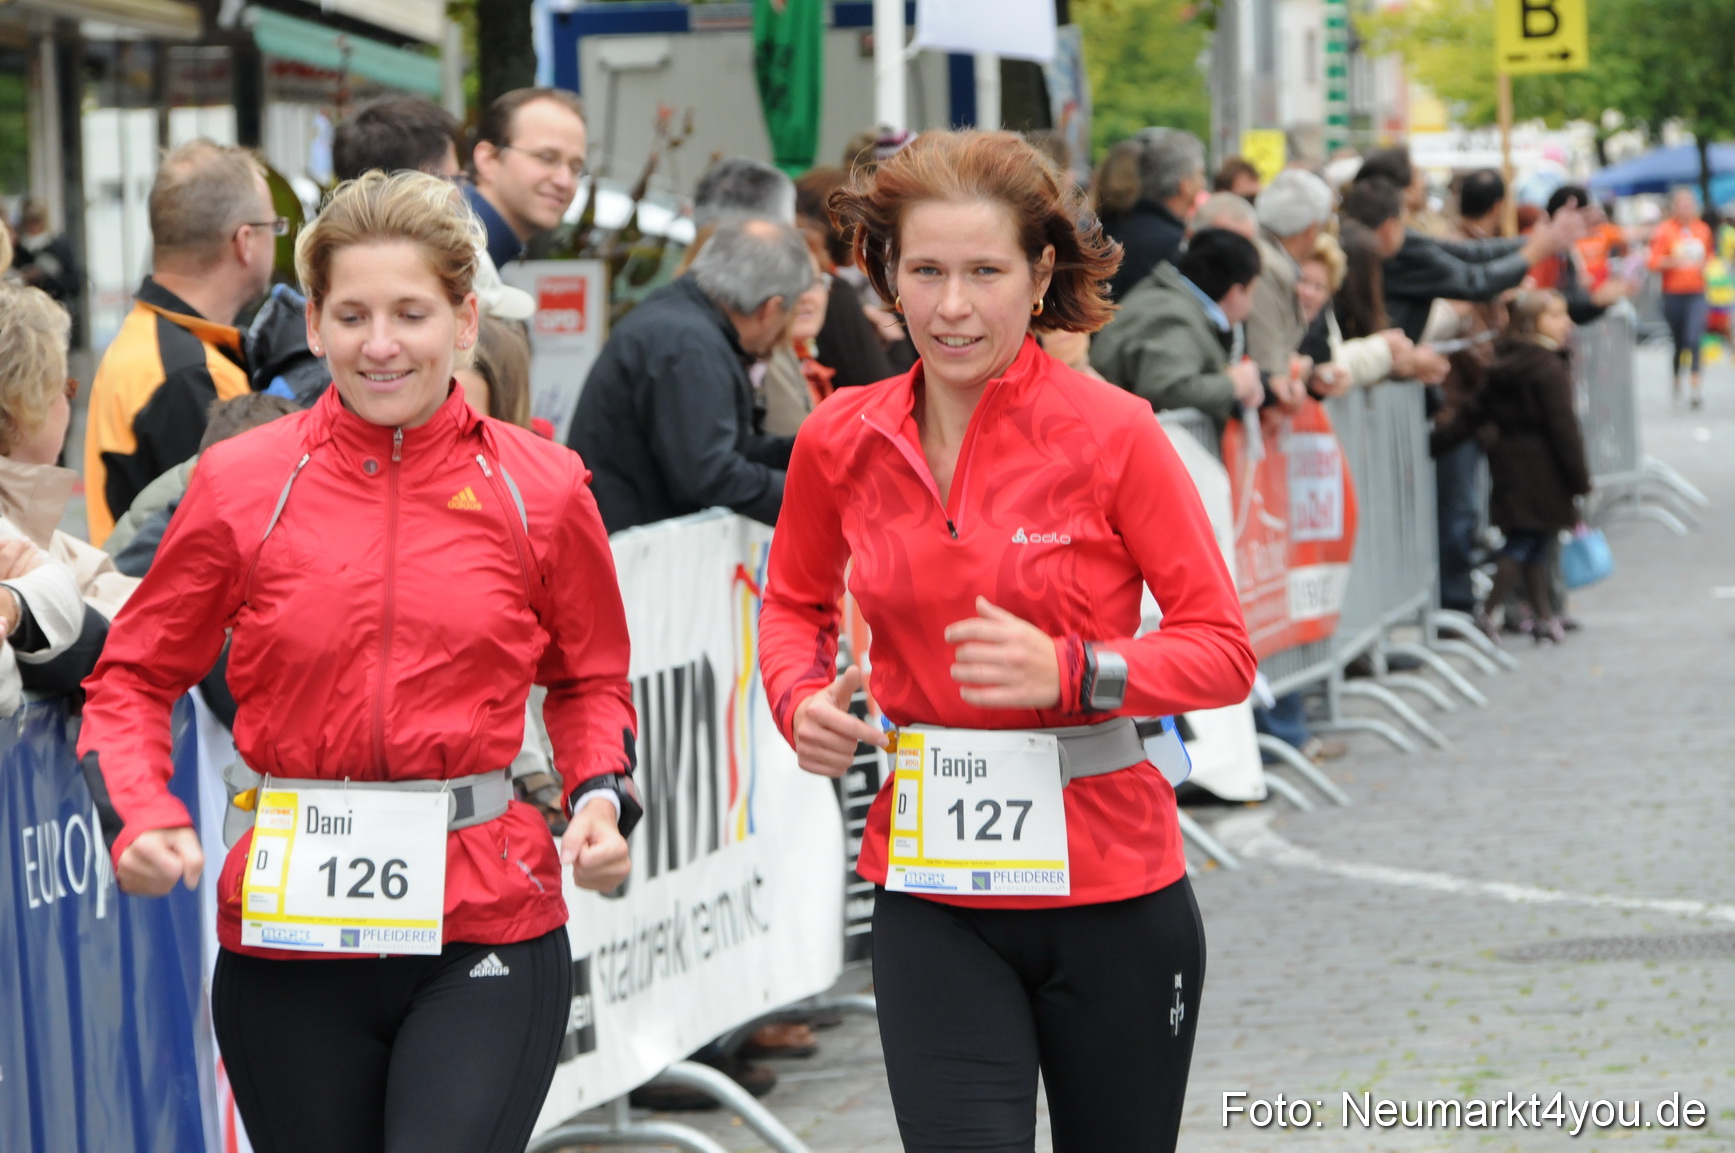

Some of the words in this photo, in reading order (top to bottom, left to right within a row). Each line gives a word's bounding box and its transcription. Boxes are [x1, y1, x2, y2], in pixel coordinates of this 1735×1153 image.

[1521, 0, 1560, 38] B
[447, 499, 482, 511] adidas
[930, 747, 988, 784] Tanja
[898, 793, 907, 815] D
[305, 804, 354, 836] Dani
[948, 798, 1033, 841] 127
[256, 850, 269, 871] D
[318, 856, 409, 900] 126
[993, 871, 1065, 884] PFLEIDERER
[363, 928, 437, 943] PFLEIDERER
[469, 965, 510, 978] adidas
